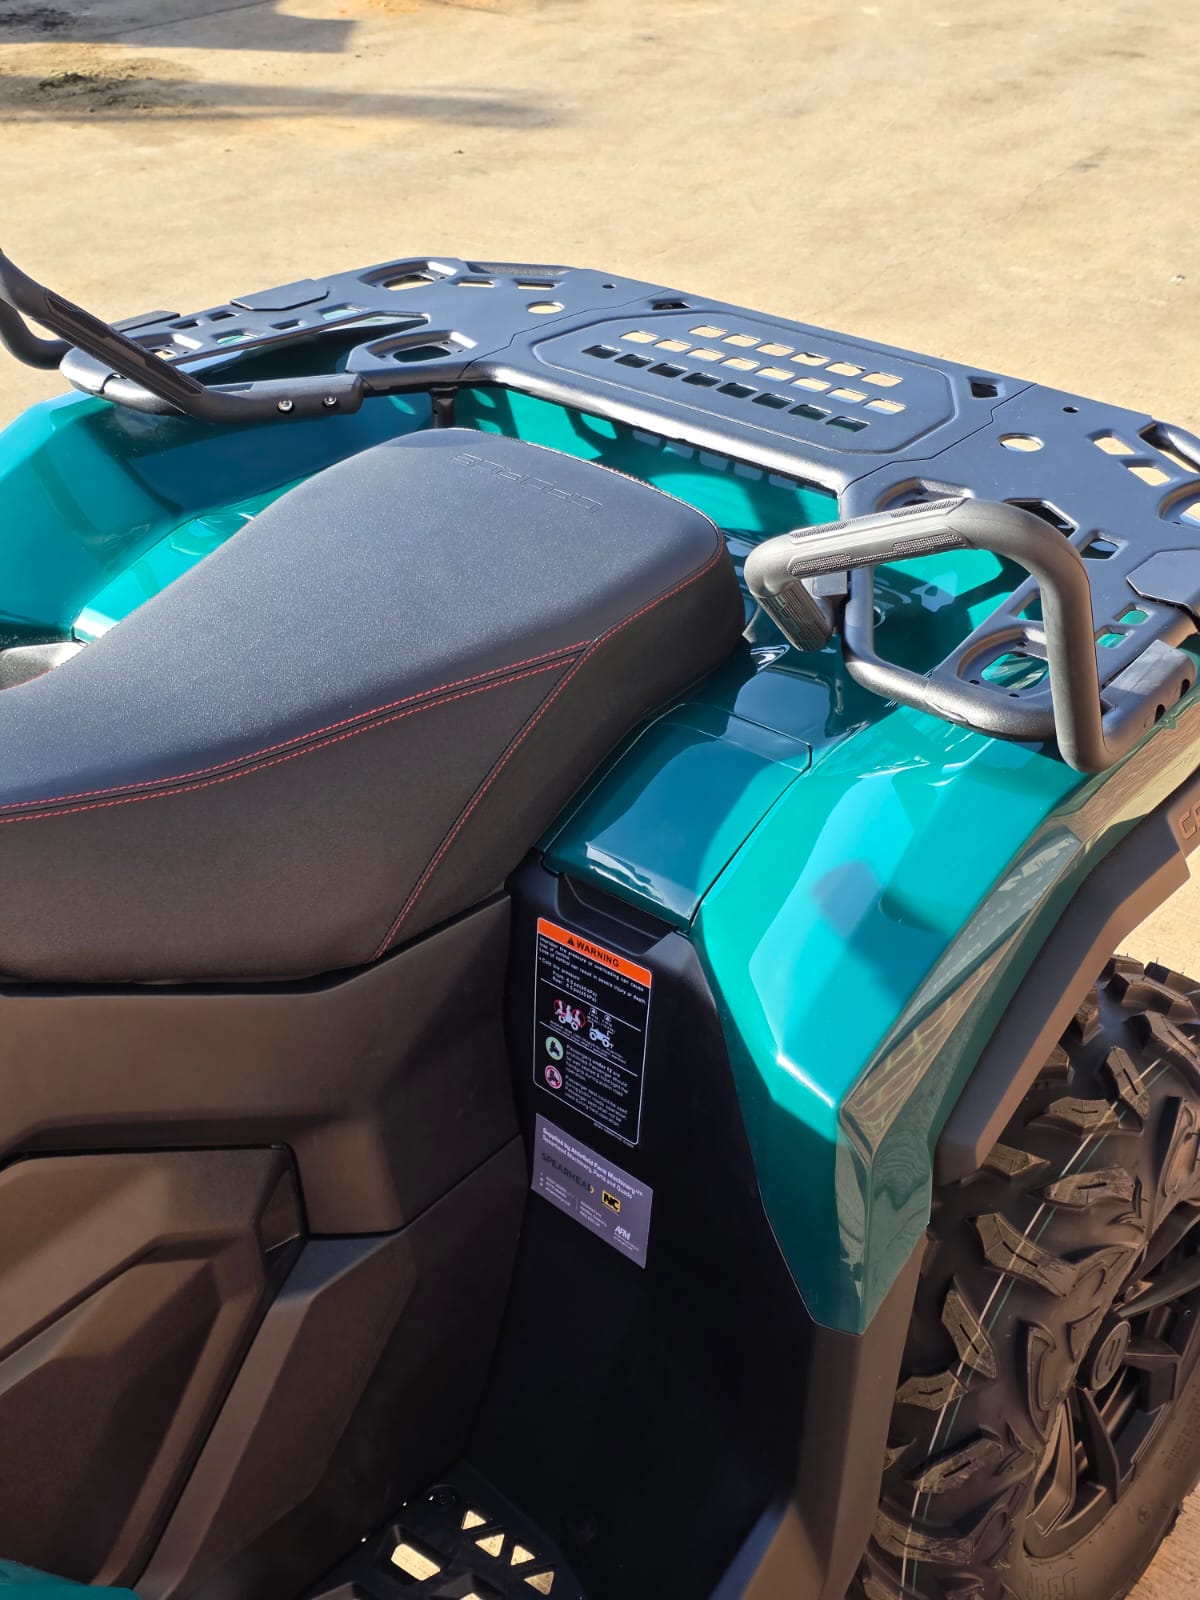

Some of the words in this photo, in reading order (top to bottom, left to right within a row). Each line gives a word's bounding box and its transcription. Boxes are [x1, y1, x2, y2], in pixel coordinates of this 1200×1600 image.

[576, 940, 620, 968] WARNING
[541, 1152, 595, 1194] SPEARHEAD
[564, 1142, 570, 1151] by
[594, 1162, 607, 1174] Farm
[607, 1171, 635, 1193] Machinery
